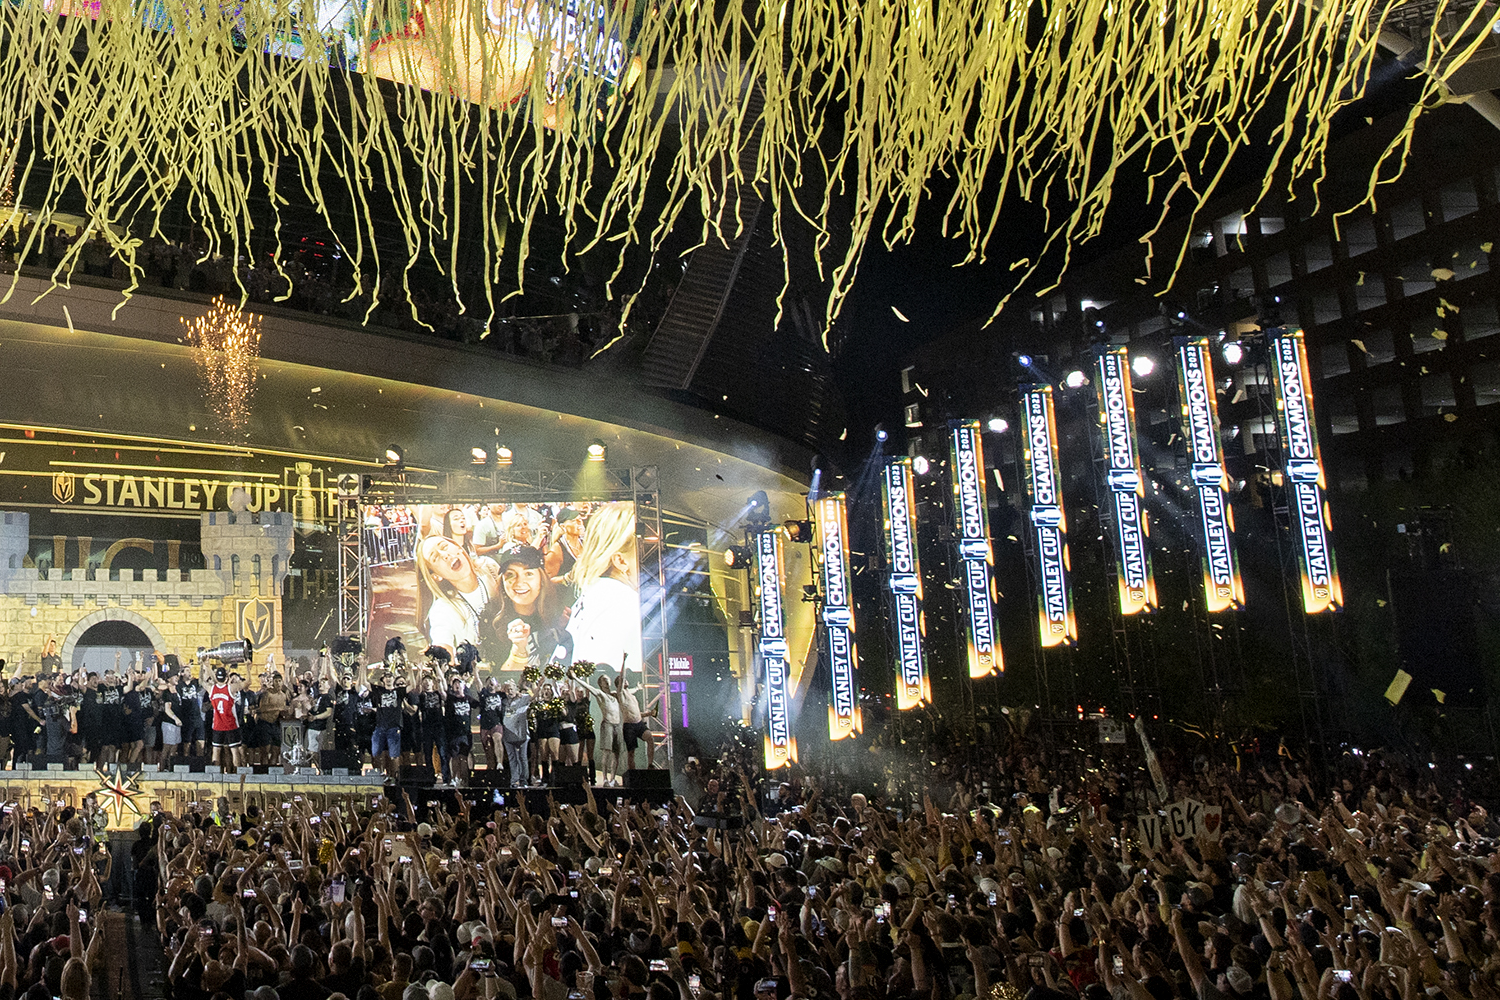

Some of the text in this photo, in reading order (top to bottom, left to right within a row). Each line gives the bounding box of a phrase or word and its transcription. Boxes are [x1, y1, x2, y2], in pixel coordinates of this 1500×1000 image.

[1106, 355, 1115, 375] 2023
[1107, 376, 1129, 468] CHAMPIONS
[1282, 339, 1328, 585] STANLEY CUP CHAMPIONS 2023
[83, 473, 280, 513] STANLEY CUP
[1032, 394, 1063, 621] STANLEY CUP CHAMPIONS 2023
[1121, 492, 1137, 522] CUP
[1188, 348, 1229, 584] STANLEY CUP CHAMPIONS 2023
[826, 521, 842, 605] CHAMPIONS
[890, 466, 919, 685] STANLEY CUP CHAMPIONS 2023
[960, 429, 991, 652] STANLEY CUP CHAMPIONS 2023
[1123, 525, 1143, 588] STANLEY
[763, 534, 786, 745] STANLEY CUP CHAMPIONS 2023
[832, 628, 845, 657] CUP
[217, 700, 224, 714] 4
[835, 658, 850, 716] STANLEY
